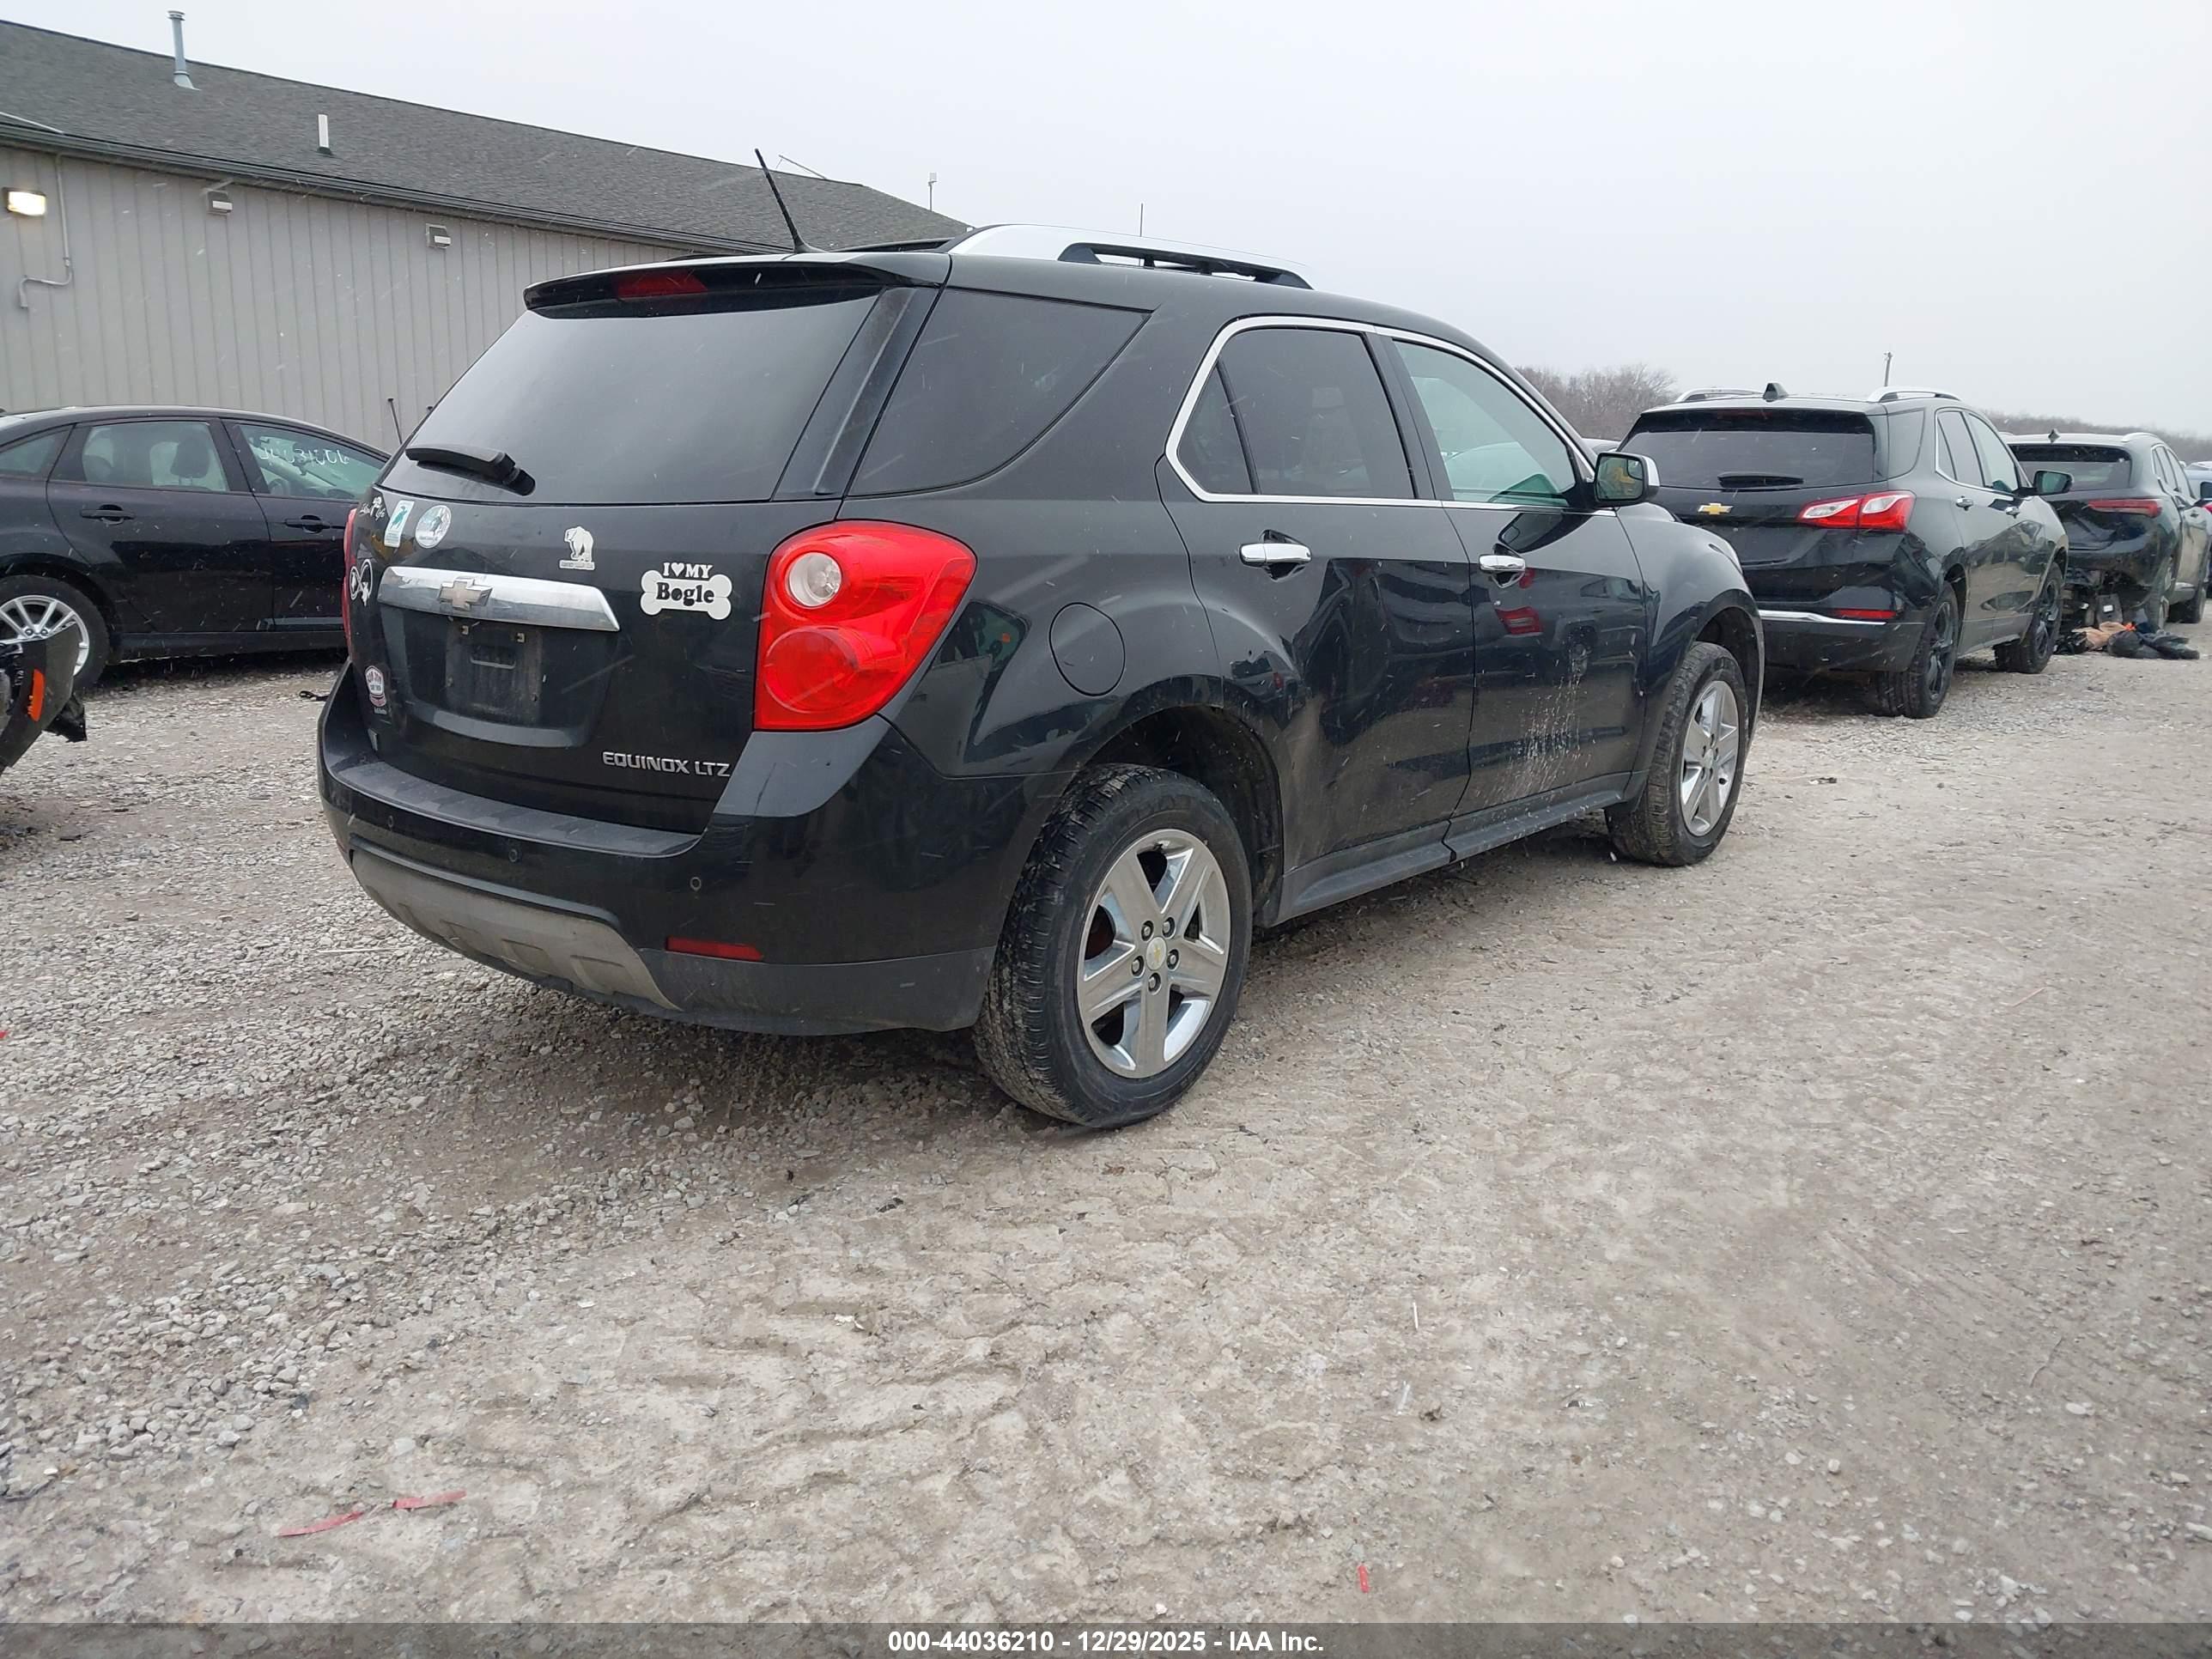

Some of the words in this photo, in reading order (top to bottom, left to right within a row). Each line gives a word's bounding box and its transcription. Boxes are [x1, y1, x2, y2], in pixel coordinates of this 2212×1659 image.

[663, 562, 670, 576] I
[685, 563, 713, 579] MY
[656, 582, 714, 606] Bogle
[603, 751, 690, 774] EQUINOX
[694, 761, 730, 777] LTZ
